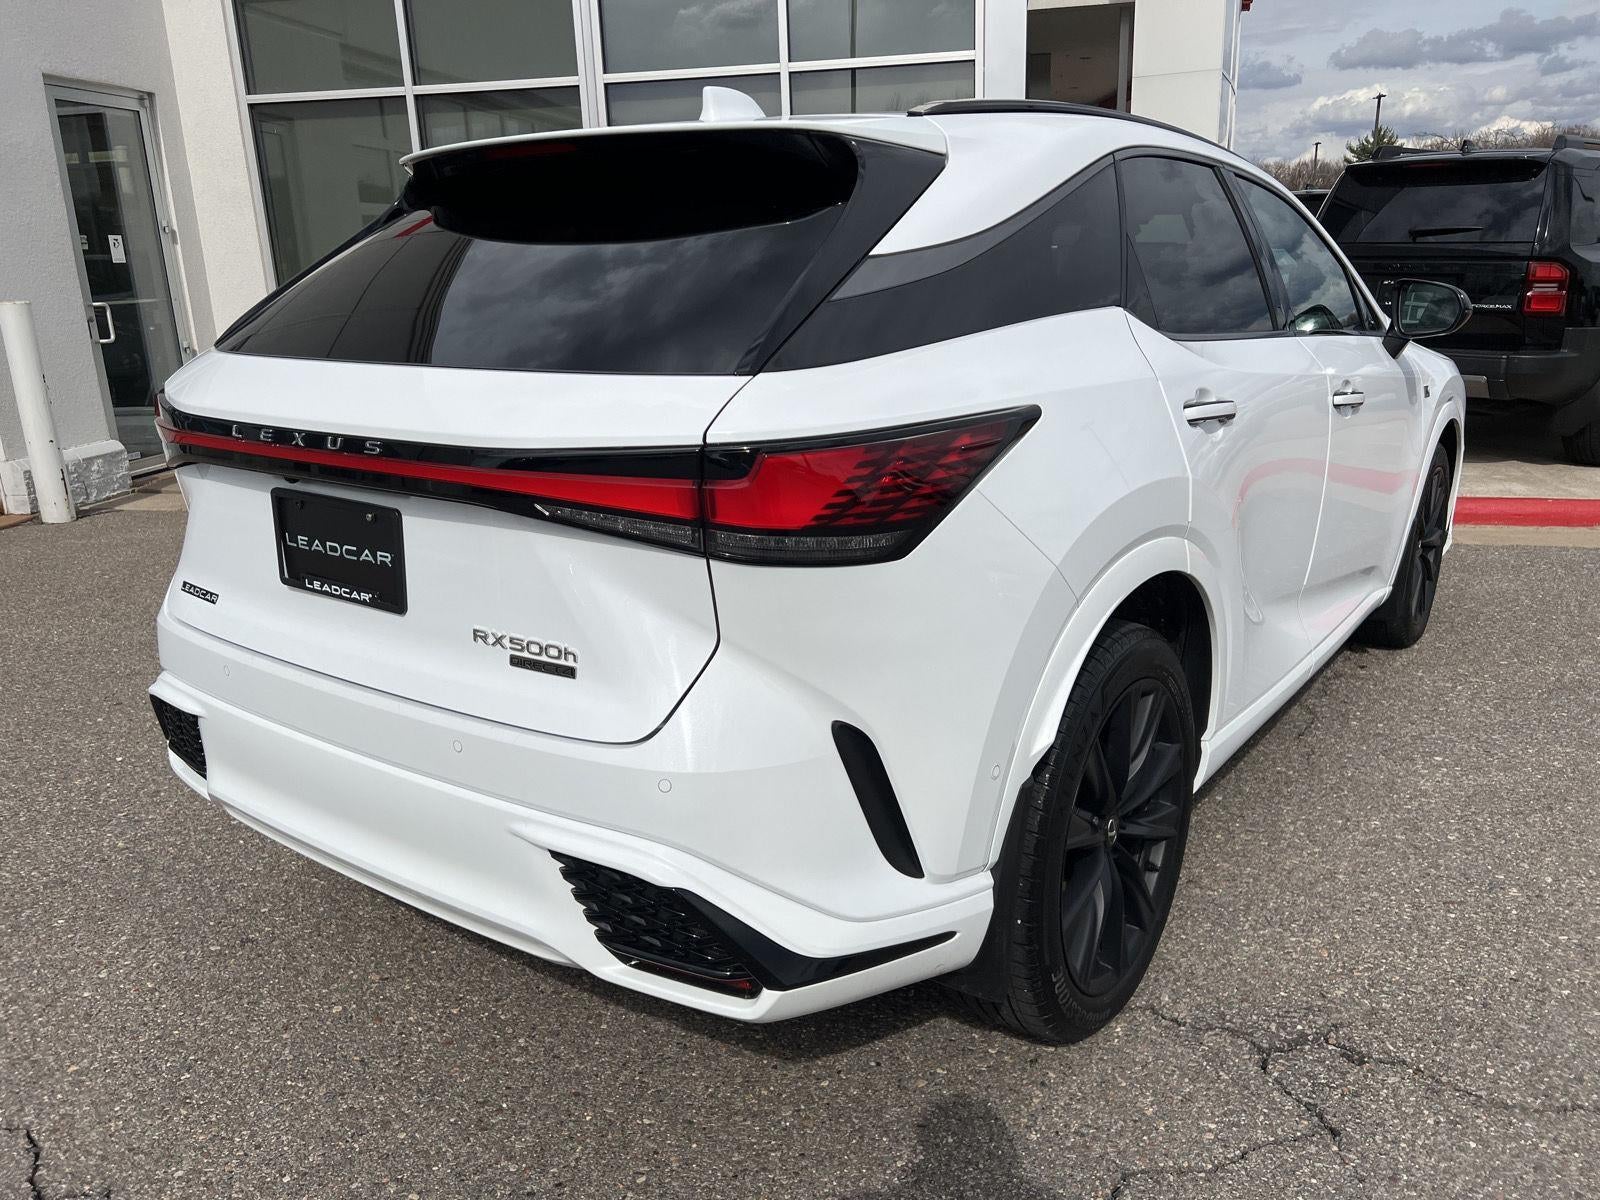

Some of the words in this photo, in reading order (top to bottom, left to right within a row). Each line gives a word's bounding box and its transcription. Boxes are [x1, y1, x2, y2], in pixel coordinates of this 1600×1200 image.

[231, 424, 383, 455] LEXUS
[285, 532, 392, 567] LEADCAR
[181, 582, 218, 603] LEADCAR
[305, 578, 370, 602] LEADCAR
